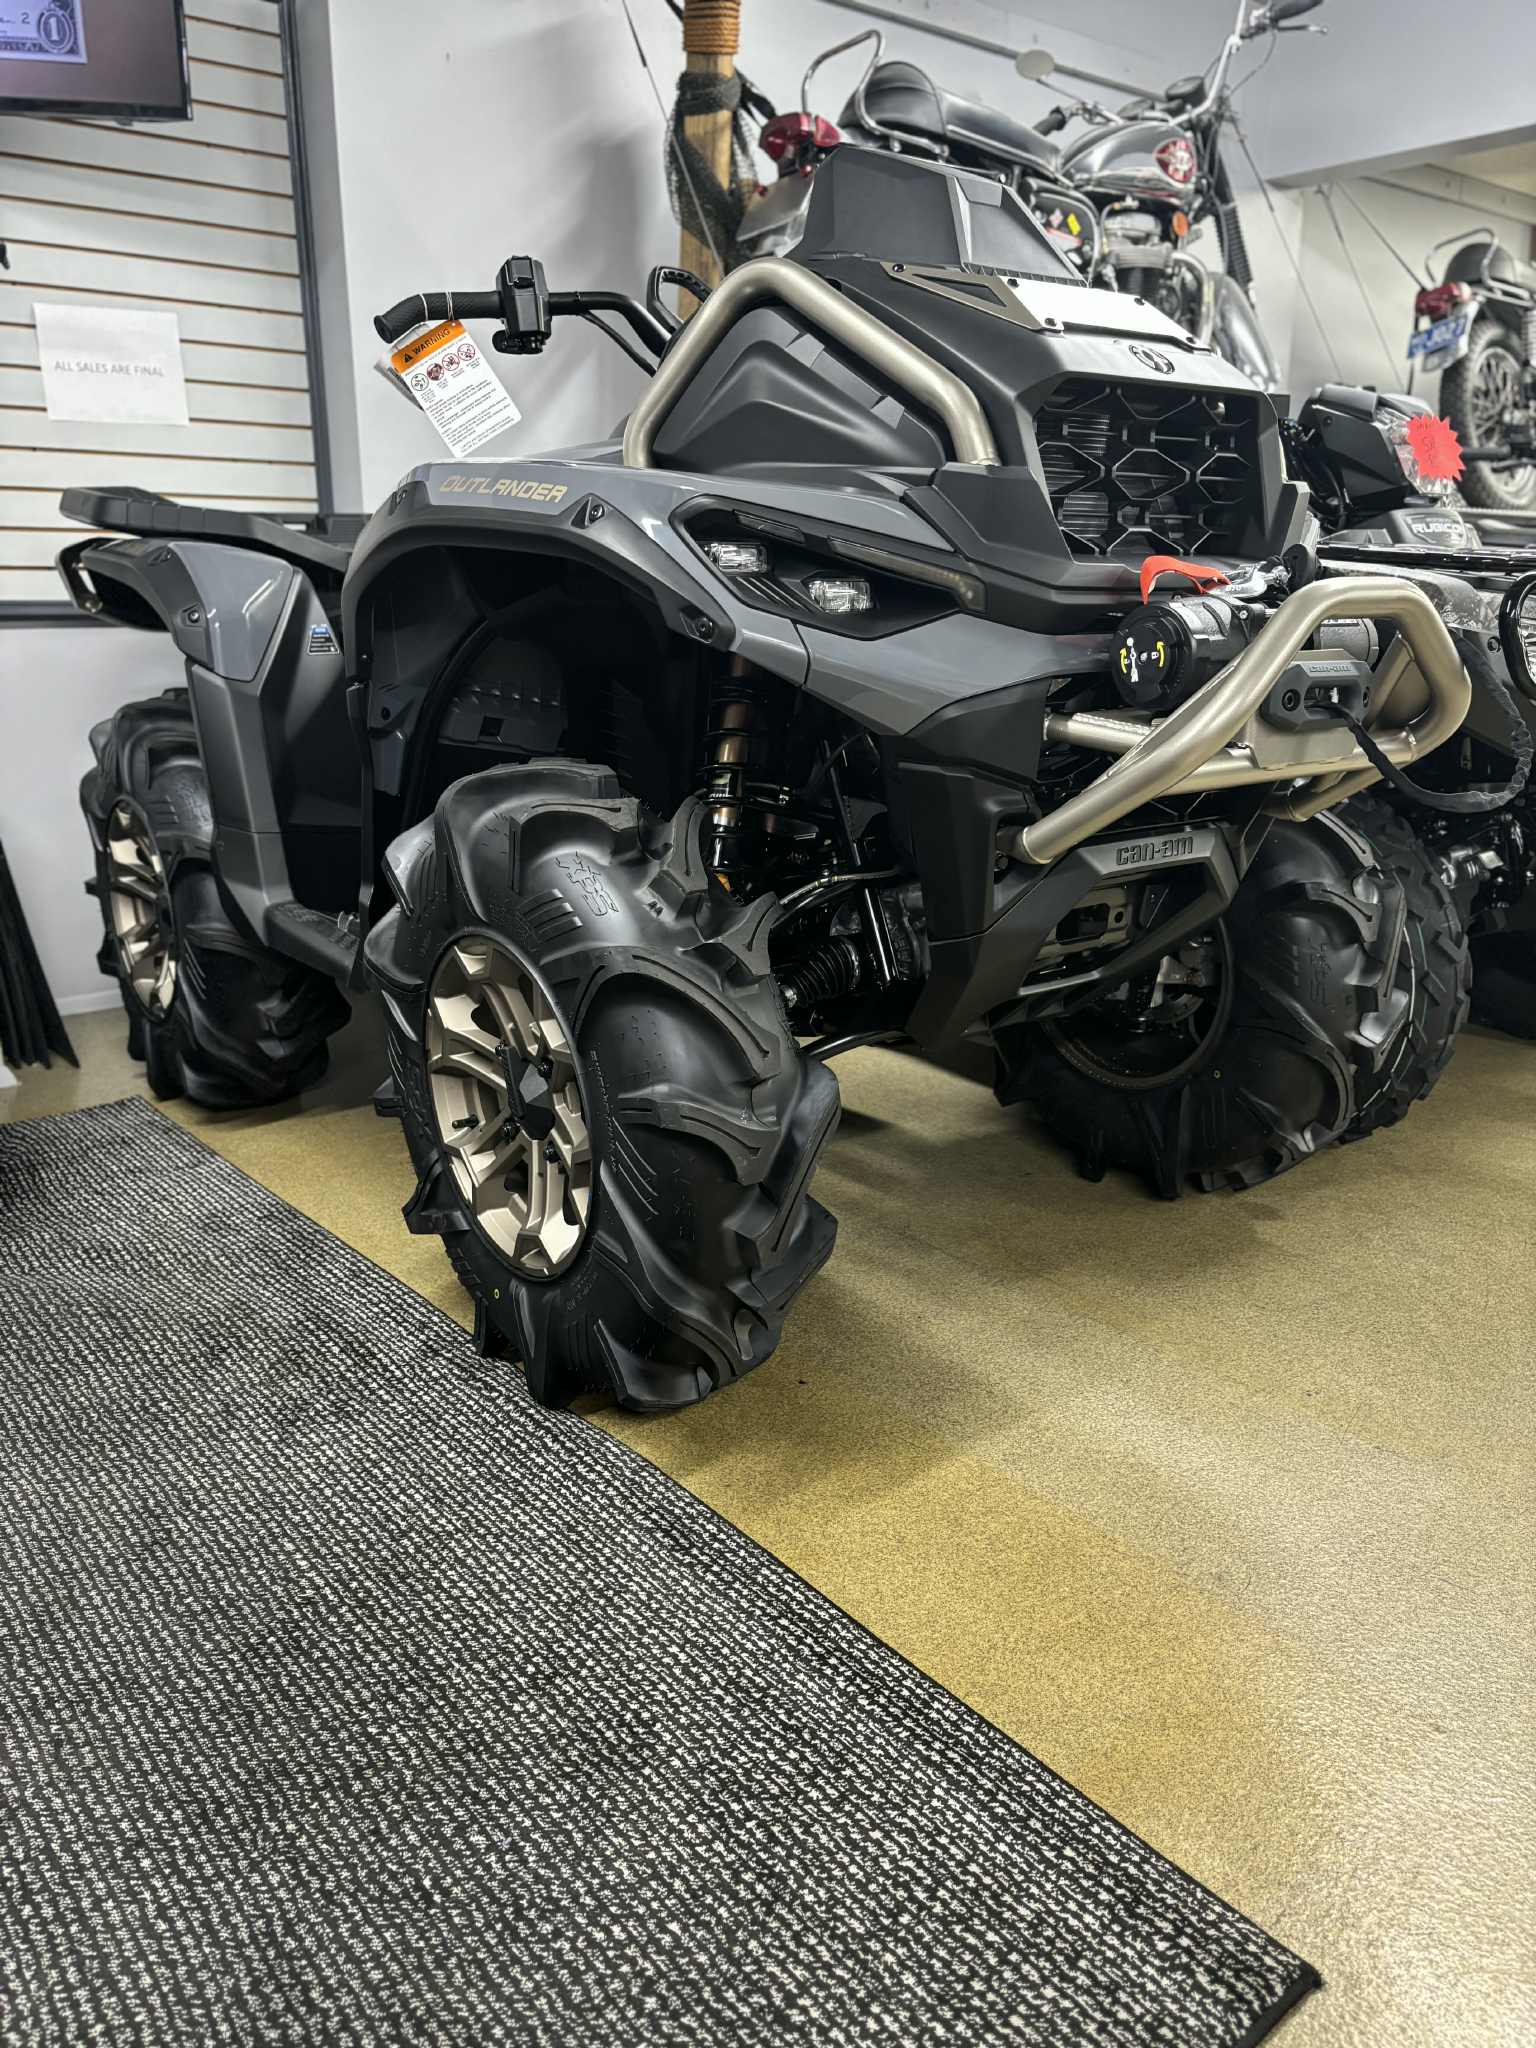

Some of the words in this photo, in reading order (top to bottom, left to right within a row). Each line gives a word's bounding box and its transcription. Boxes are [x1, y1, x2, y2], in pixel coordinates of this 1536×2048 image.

[21, 11, 31, 25] 2
[412, 327, 450, 355] WARNING
[54, 360, 74, 373] ALL
[75, 361, 109, 375] SALES
[110, 362, 132, 376] ARE
[133, 364, 166, 378] FINAL
[439, 474, 568, 503] OUTLANDER
[1411, 522, 1462, 534] RUBICO
[1115, 836, 1194, 866] can-am
